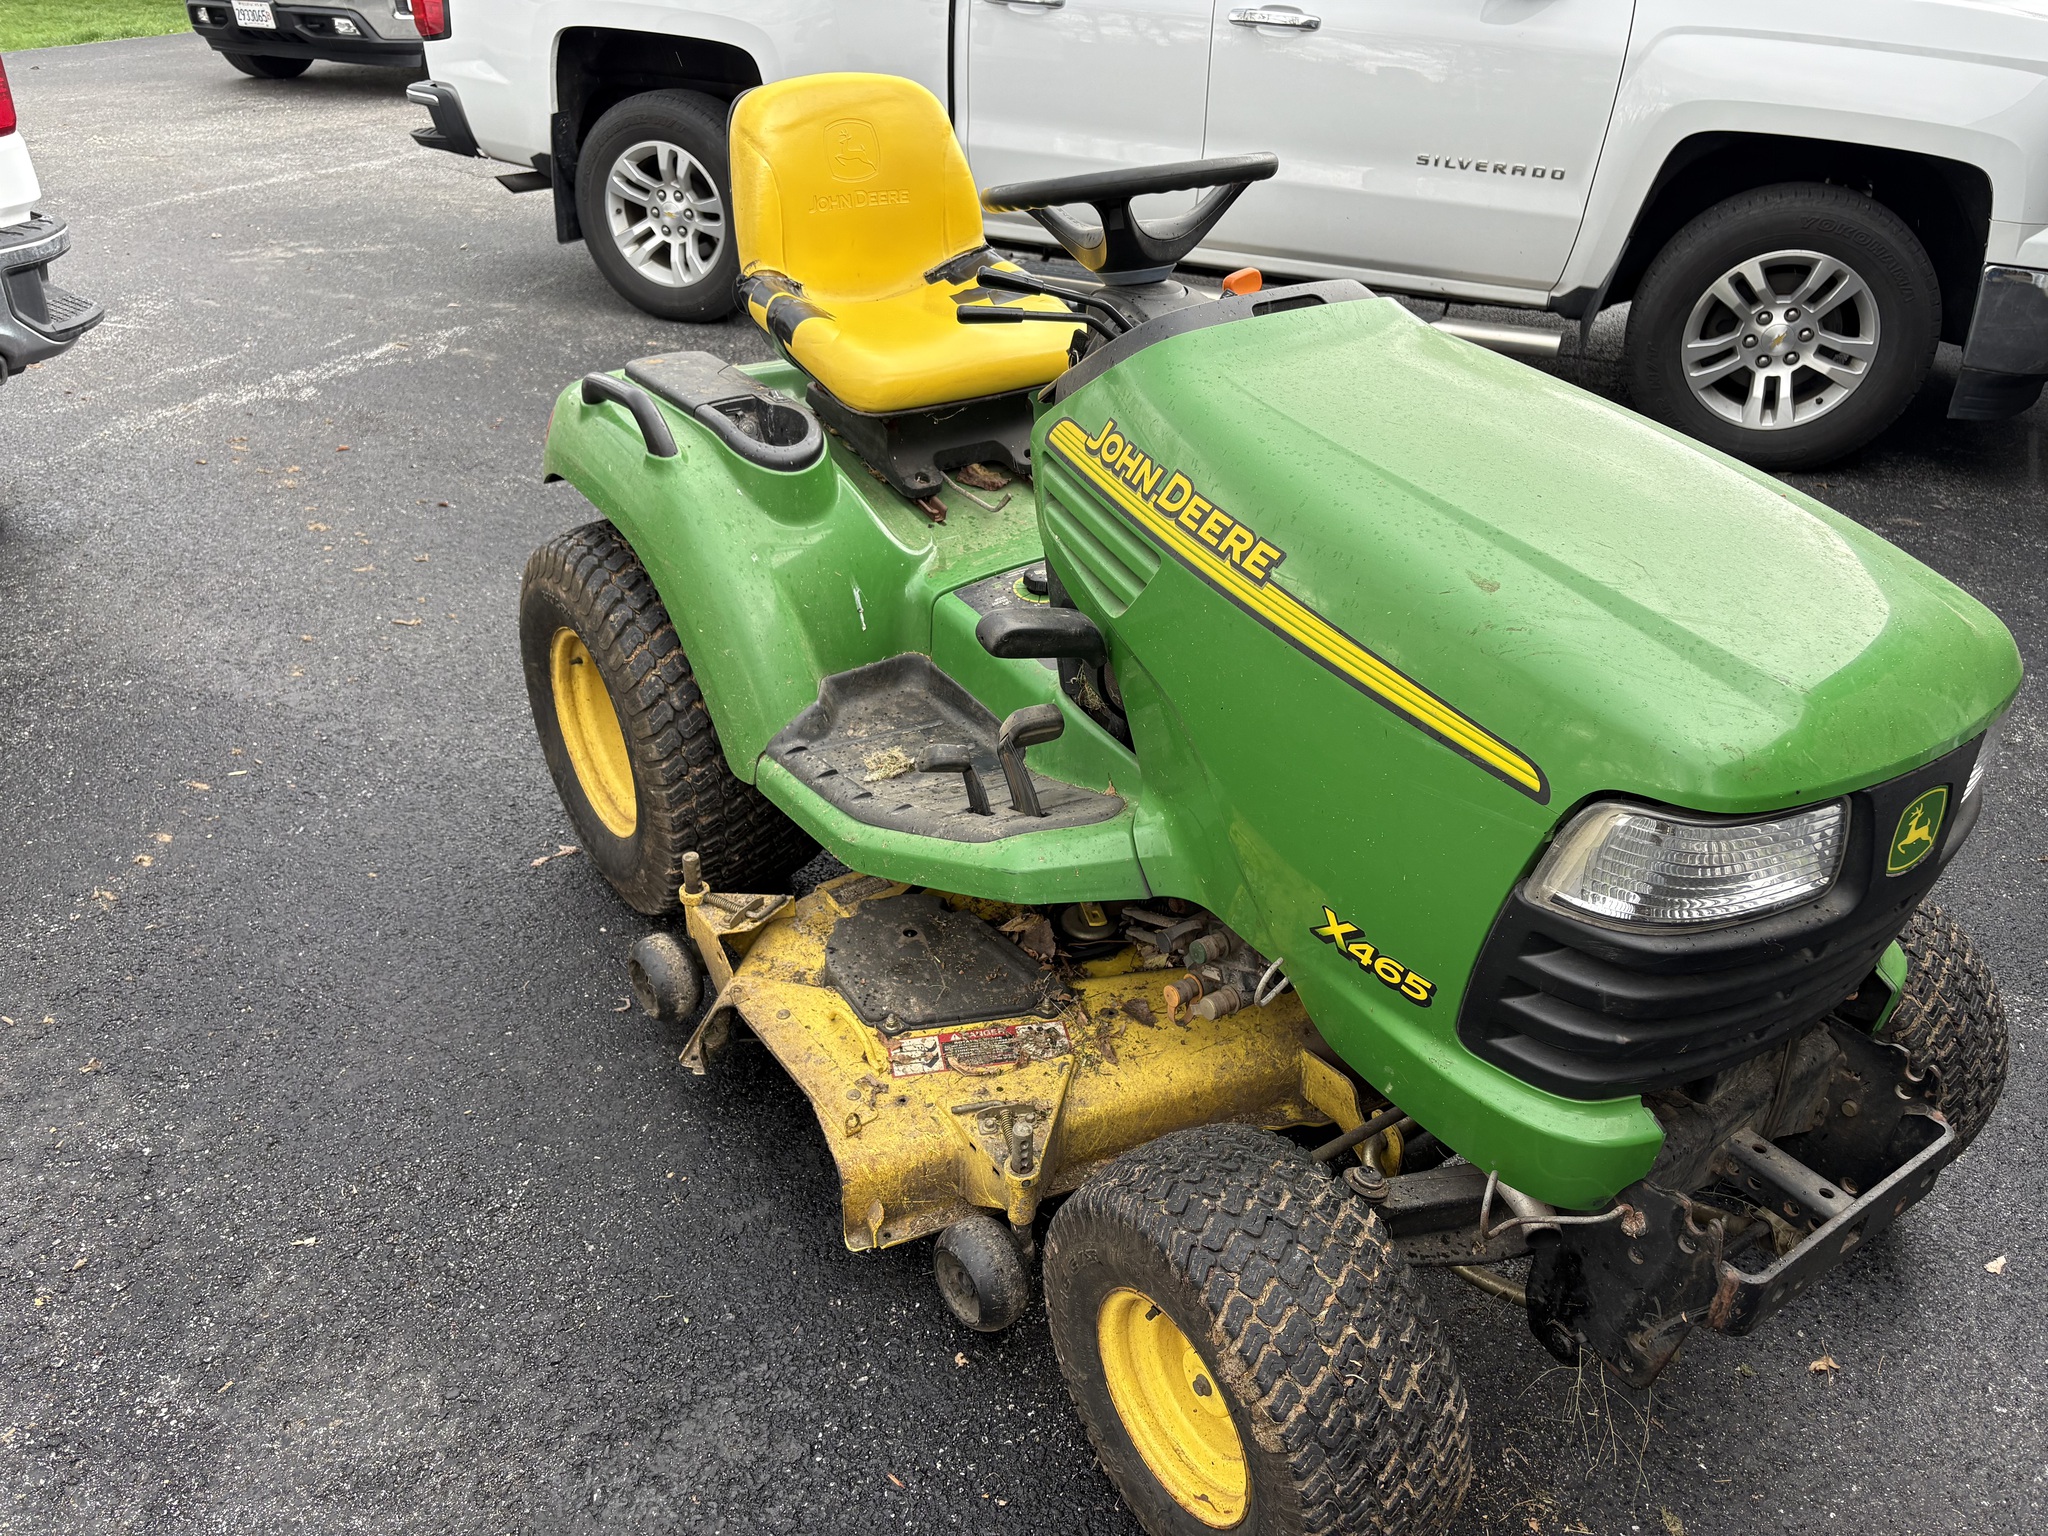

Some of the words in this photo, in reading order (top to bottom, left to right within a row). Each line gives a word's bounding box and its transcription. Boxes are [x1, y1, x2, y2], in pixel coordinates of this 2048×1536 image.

[1416, 153, 1566, 181] SILVERADO
[808, 194, 853, 214] JOHN
[854, 189, 910, 208] DEERE
[1800, 215, 1916, 304] YOKOHAMA
[1085, 417, 1167, 498] JOHN
[1155, 470, 1285, 584] DEERE
[1310, 905, 1437, 1006] X465
[963, 1026, 1006, 1039] ANGER
